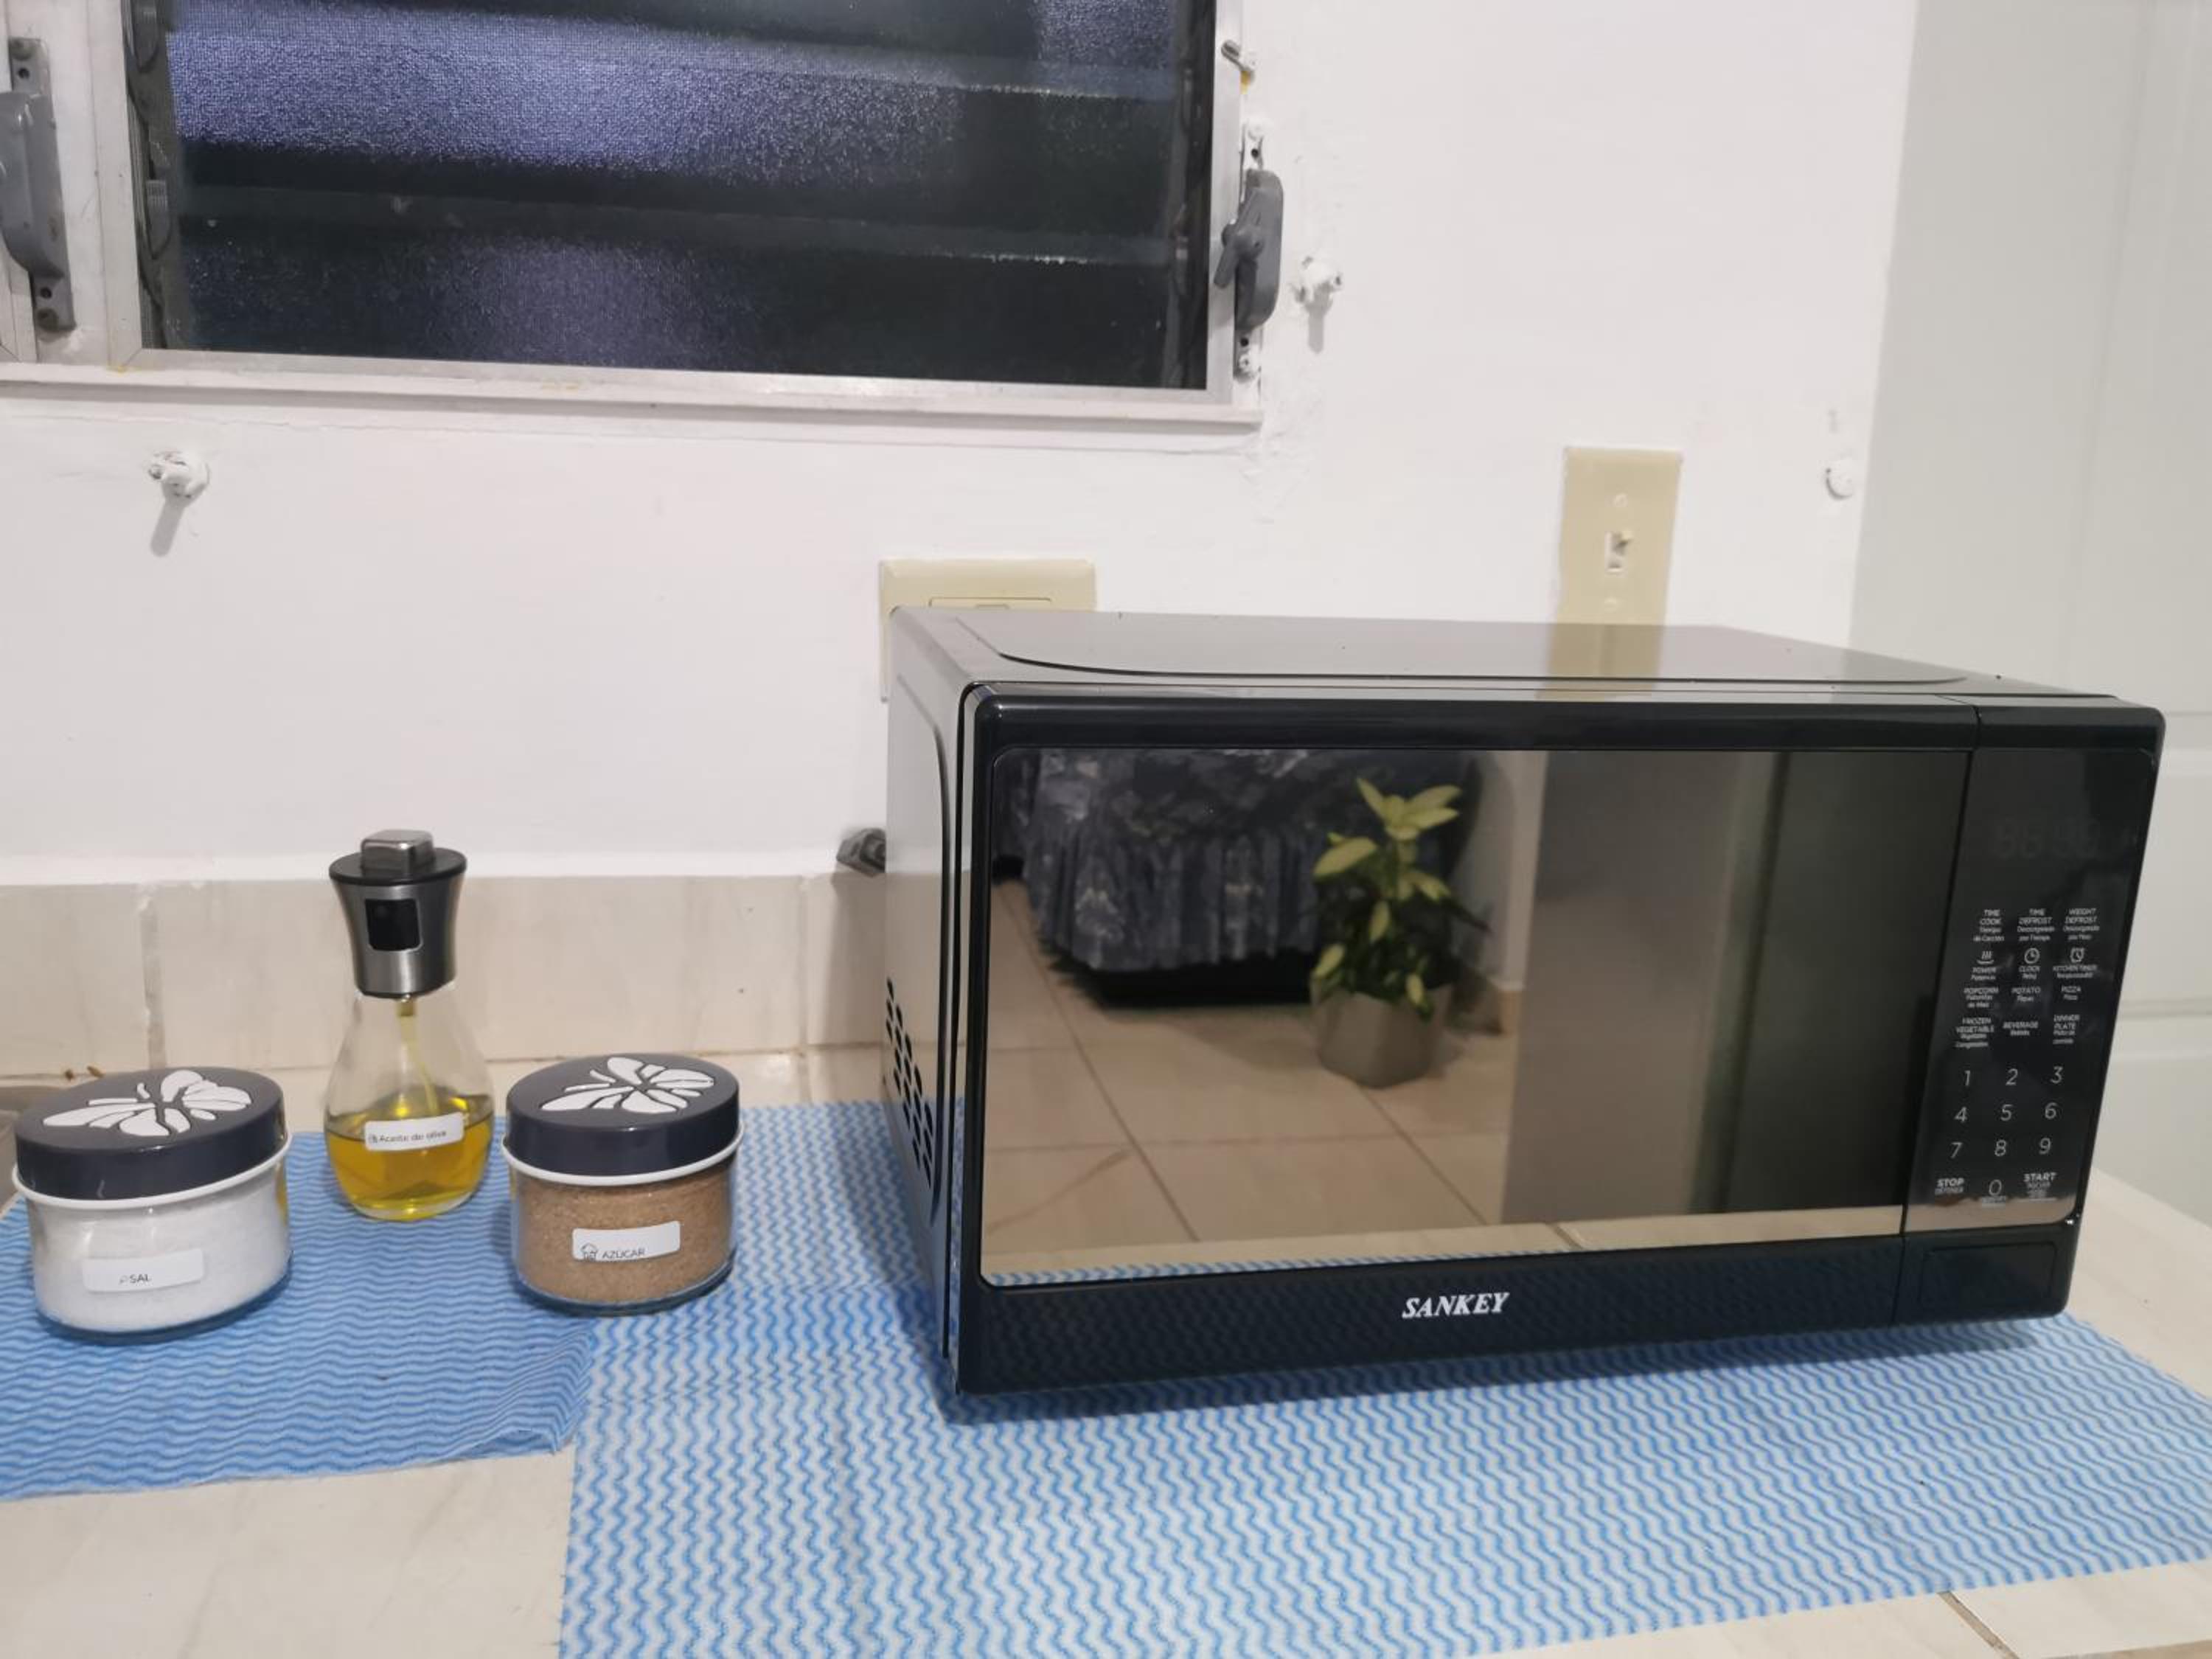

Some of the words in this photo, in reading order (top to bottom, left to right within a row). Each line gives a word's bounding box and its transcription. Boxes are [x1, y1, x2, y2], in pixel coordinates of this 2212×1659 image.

[2011, 986, 2041, 994] POTATO
[1964, 1070, 1971, 1086] 1
[2006, 1068, 2018, 1085] 2
[2050, 1065, 2063, 1084] 3
[1954, 1107, 1967, 1122] 4
[2000, 1104, 2014, 1121] 5
[2045, 1102, 2058, 1119] 6
[1950, 1141, 1963, 1158] 7
[1994, 1139, 2006, 1156] 8
[2039, 1138, 2051, 1155] 9
[1936, 1178, 1965, 1187] STOP
[2024, 1172, 2057, 1182] START
[1989, 1180, 2002, 1196] 0
[129, 1273, 151, 1284] SAL
[1402, 1292, 1510, 1318] SANKEY
